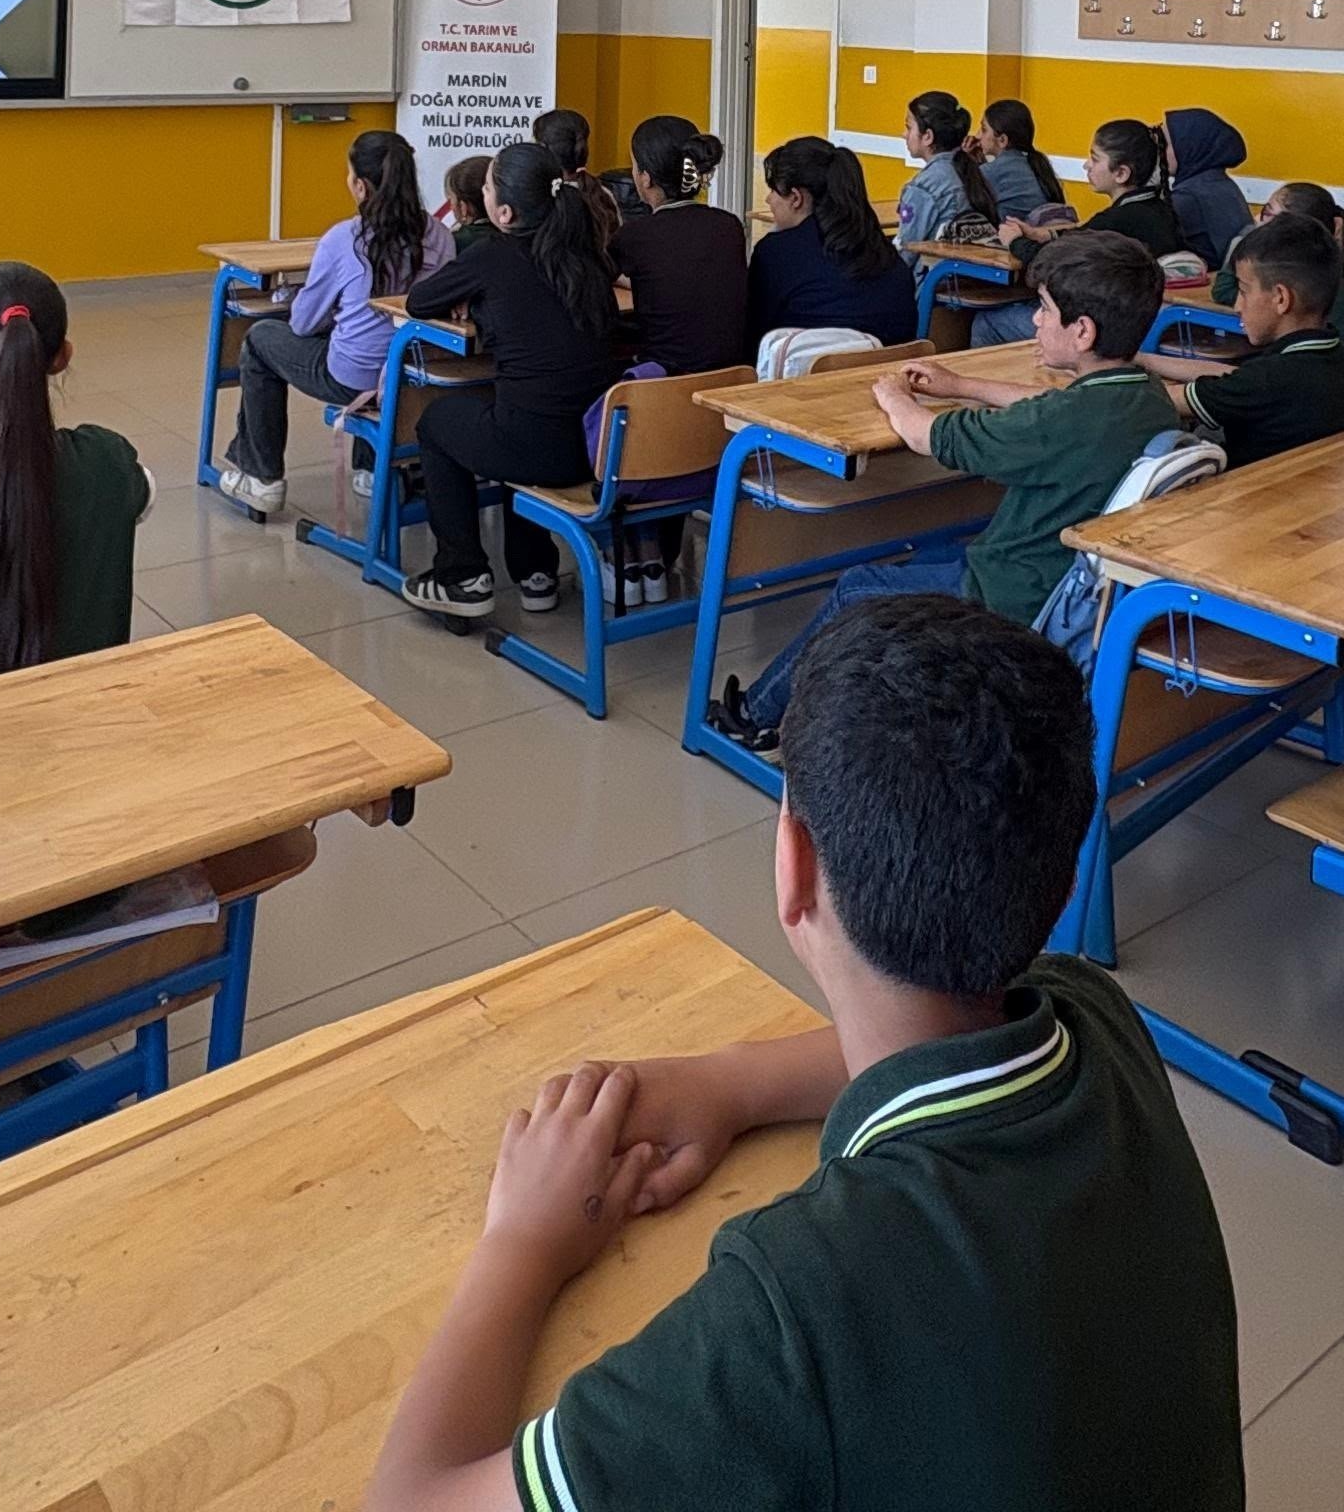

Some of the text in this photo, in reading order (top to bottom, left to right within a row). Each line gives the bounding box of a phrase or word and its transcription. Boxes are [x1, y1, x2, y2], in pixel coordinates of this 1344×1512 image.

[440, 24, 518, 37] T.C. TARIM VE
[421, 41, 535, 54] ORMAN BAKANLIĞI
[447, 72, 507, 88] MARDİN
[410, 92, 543, 109] DOĞA KORUMA VE
[422, 111, 530, 128] MİLLİ PARKLAR
[427, 131, 524, 148] MÜDÜRLÜĞÜ
